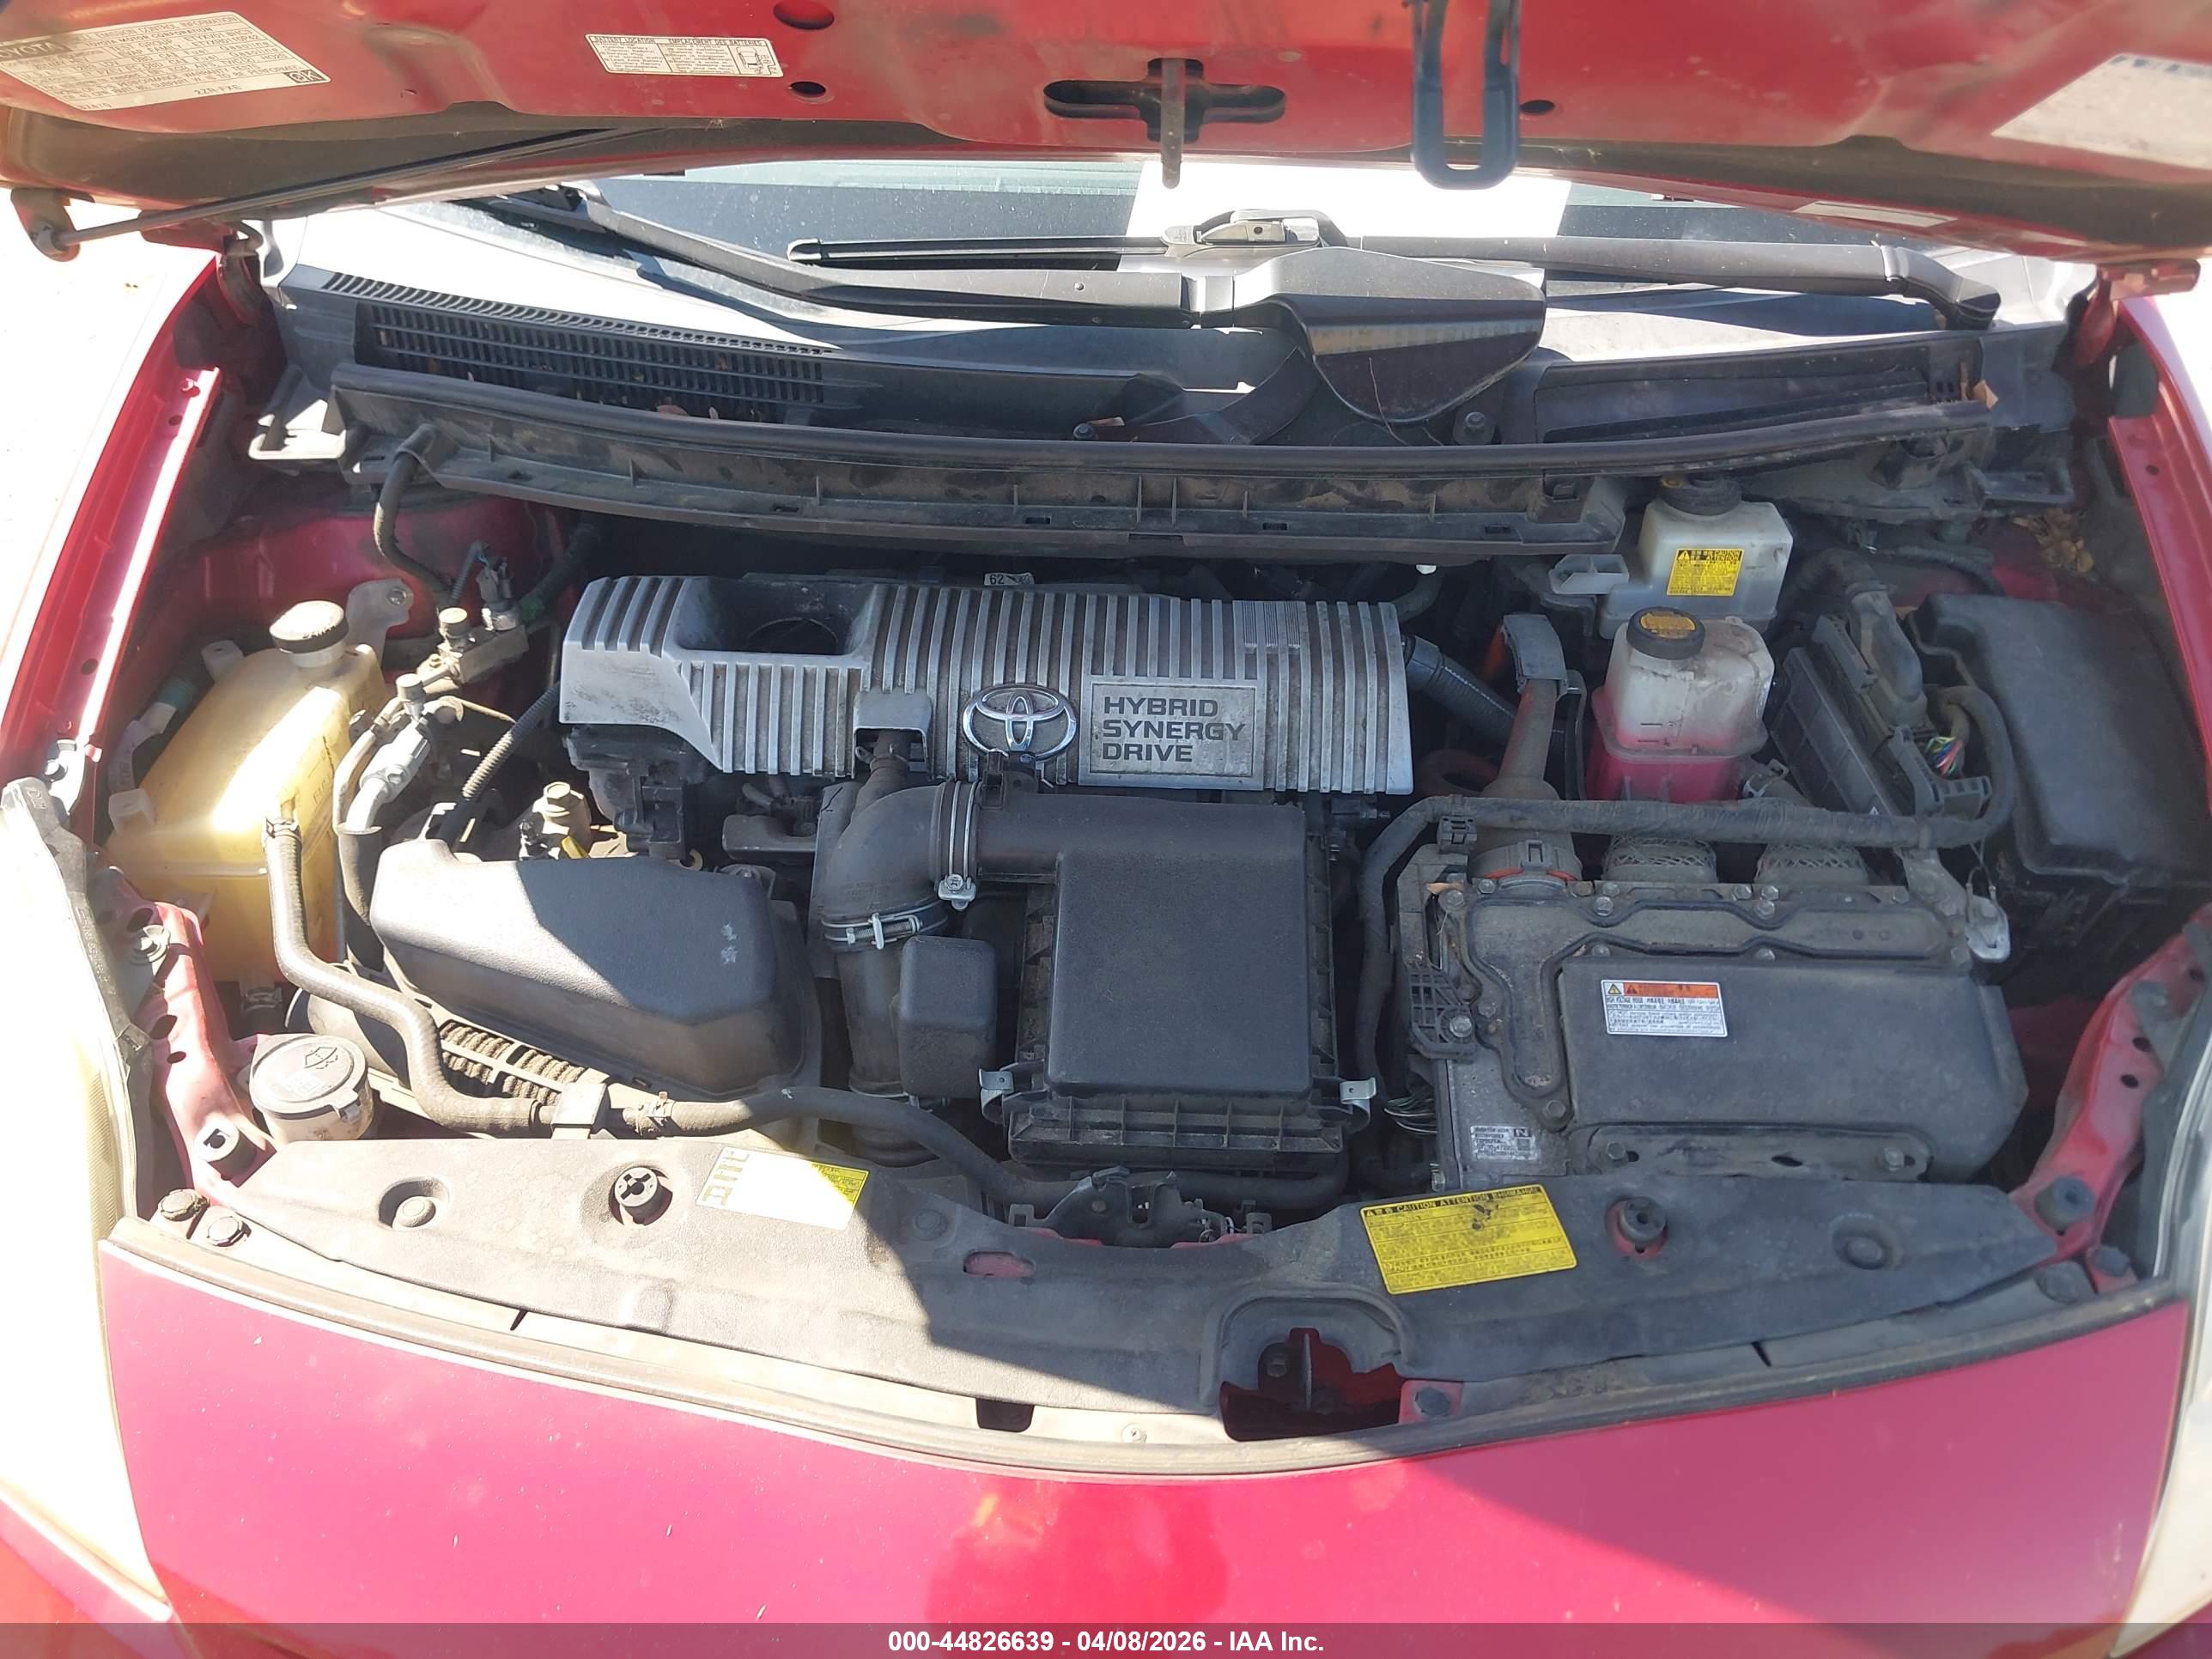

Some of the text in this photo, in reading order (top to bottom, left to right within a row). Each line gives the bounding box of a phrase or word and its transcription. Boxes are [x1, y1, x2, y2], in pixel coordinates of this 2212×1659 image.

[151, 27, 213, 39] CORPORATION
[0, 42, 62, 58] OYOTA
[229, 47, 280, 57] Gasoline
[989, 574, 1005, 585] 62
[1104, 696, 1218, 717] HYBRID
[1103, 720, 1245, 741] SYNERGY
[1103, 743, 1193, 763] DRIVE
[1396, 1201, 1437, 1212] CAUTION
[1440, 1194, 1489, 1206] ATTENTION
